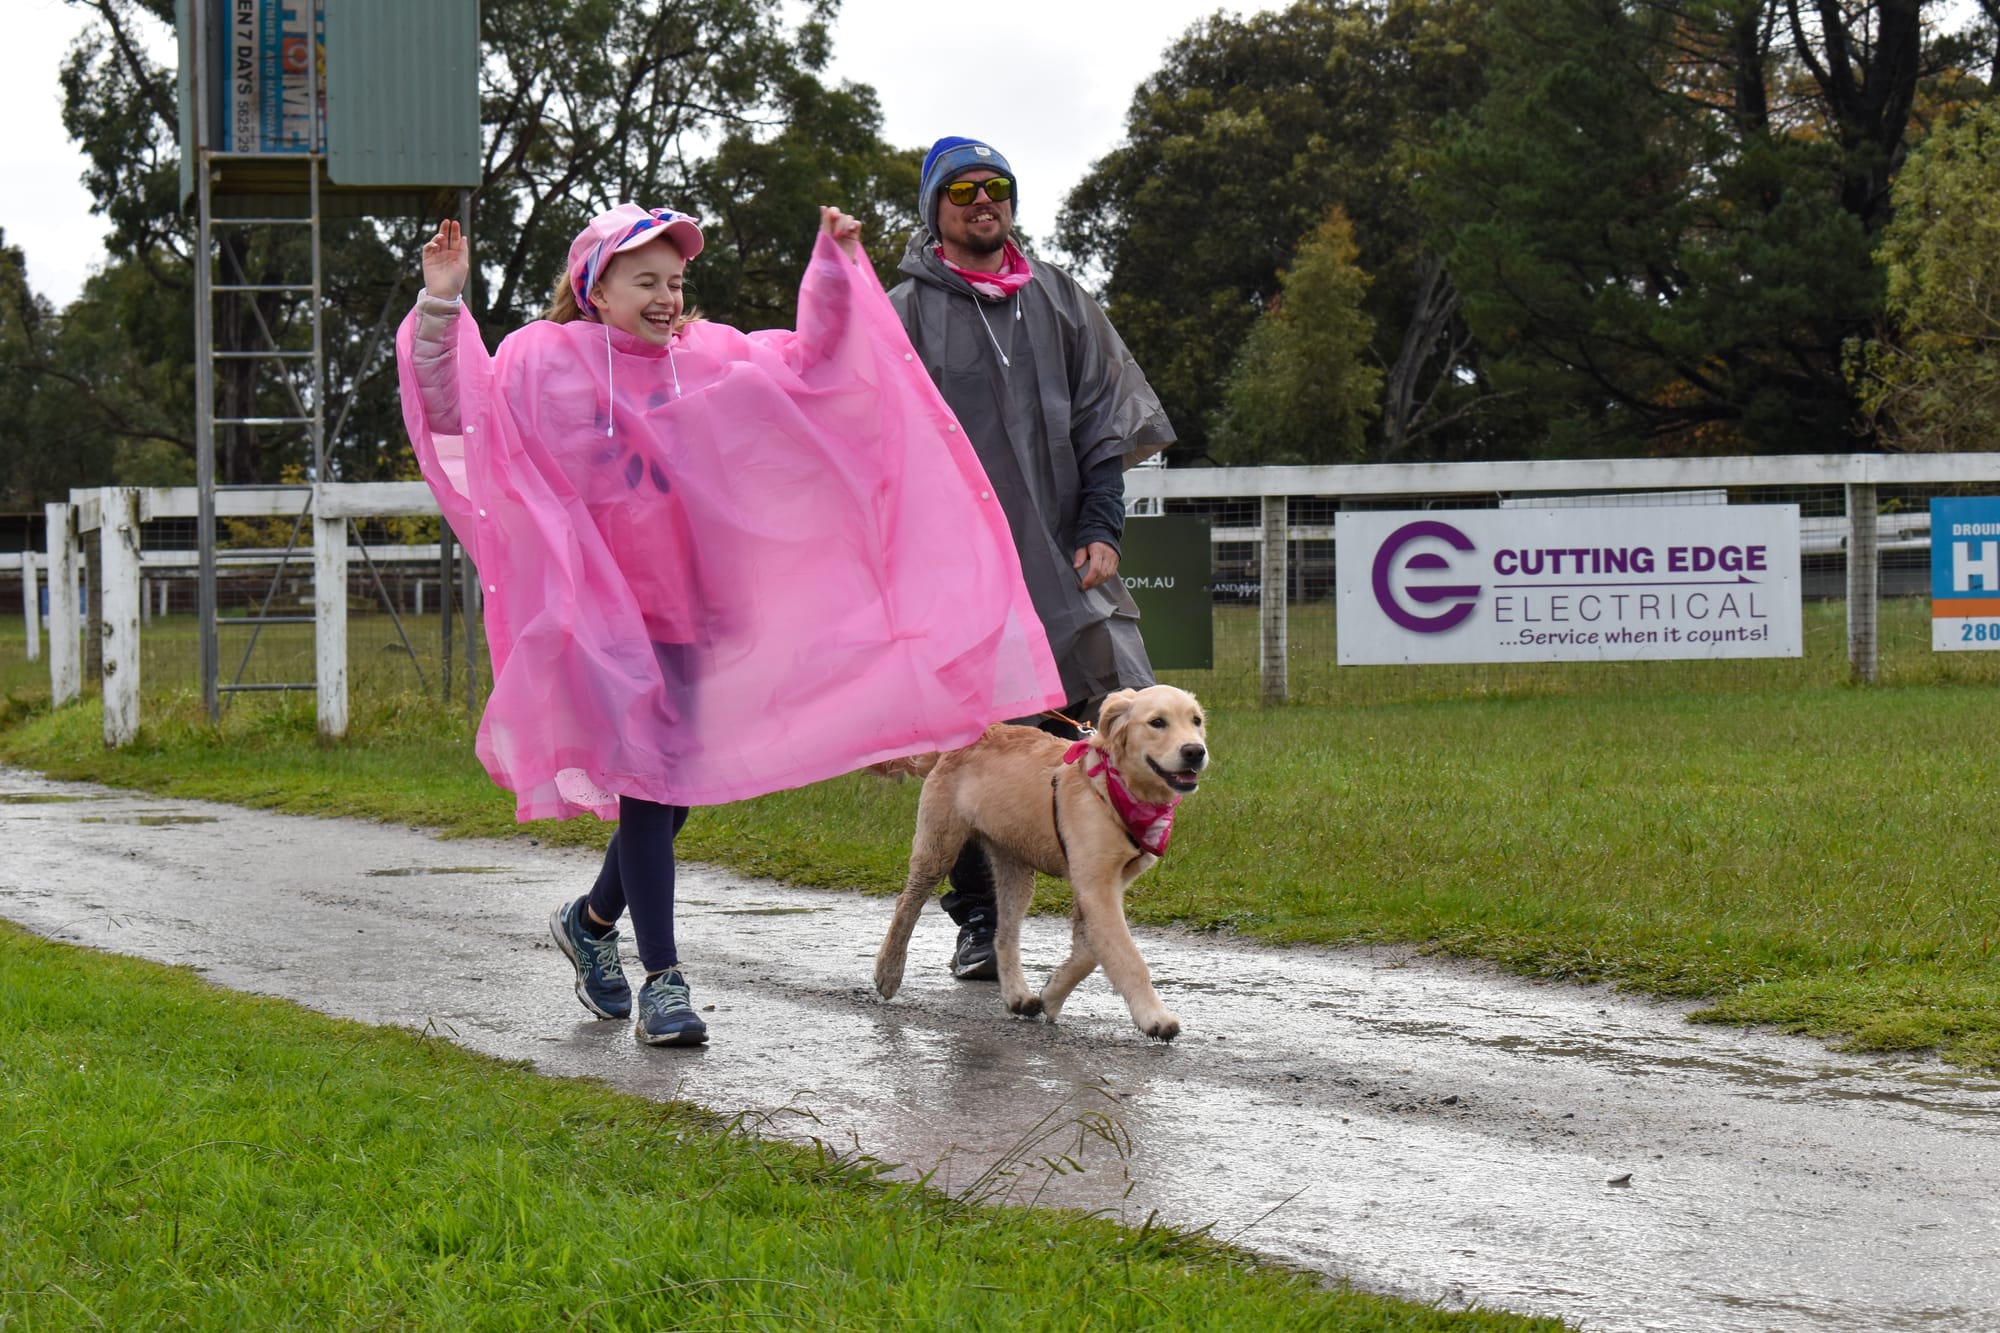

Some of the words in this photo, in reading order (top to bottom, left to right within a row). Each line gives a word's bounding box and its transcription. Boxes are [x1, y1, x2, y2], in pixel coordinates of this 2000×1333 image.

[238, 30, 253, 41] 7
[238, 46, 253, 95] DAYS
[265, 50, 276, 76] AND
[238, 101, 249, 133] 5625
[1493, 547, 1655, 576] CUTTING
[1667, 545, 1768, 573] EDGE
[1119, 576, 1175, 589] OM.AU
[1495, 592, 1768, 623] ELECTRICAL
[1605, 626, 1658, 644] when
[1664, 626, 1682, 643] it
[1687, 624, 1768, 642] counts!
[1961, 623, 2000, 641] 280
